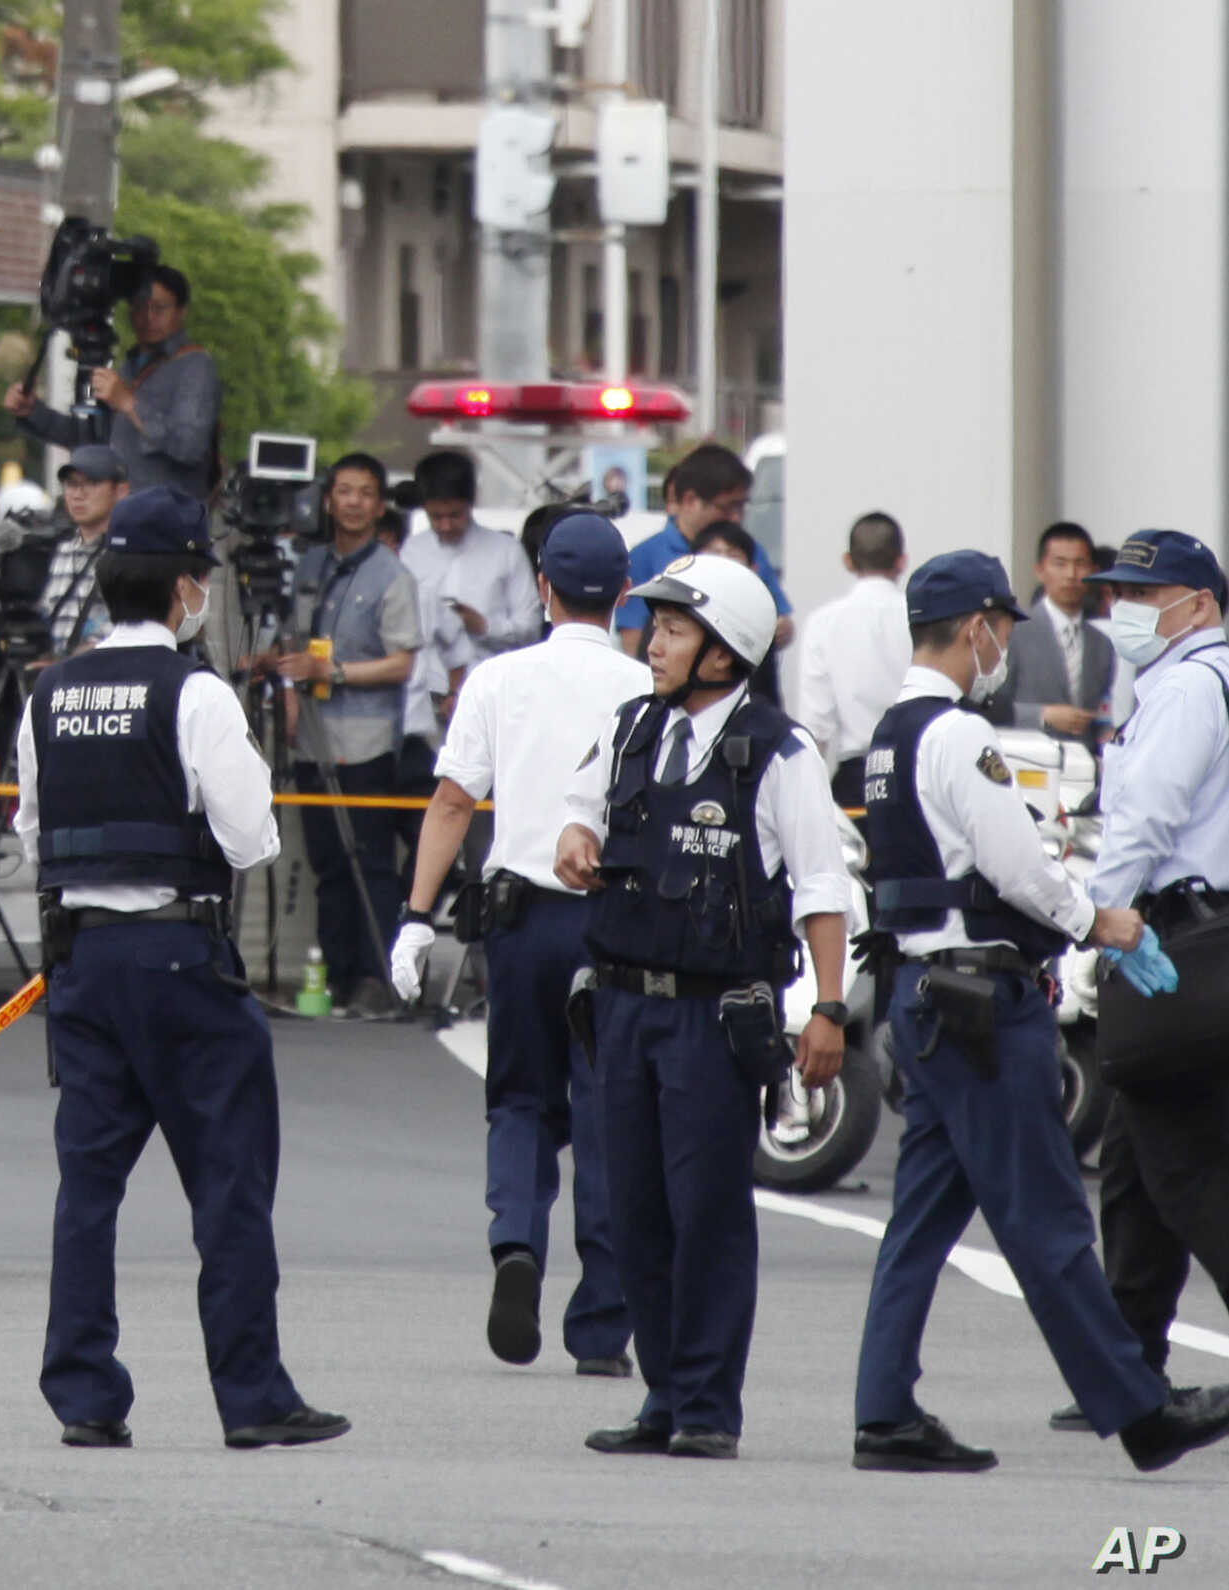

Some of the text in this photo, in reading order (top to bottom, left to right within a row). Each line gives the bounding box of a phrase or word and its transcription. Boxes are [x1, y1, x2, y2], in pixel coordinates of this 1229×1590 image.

[50, 685, 149, 714] 神奈川県警察
[55, 713, 133, 738] POLICE
